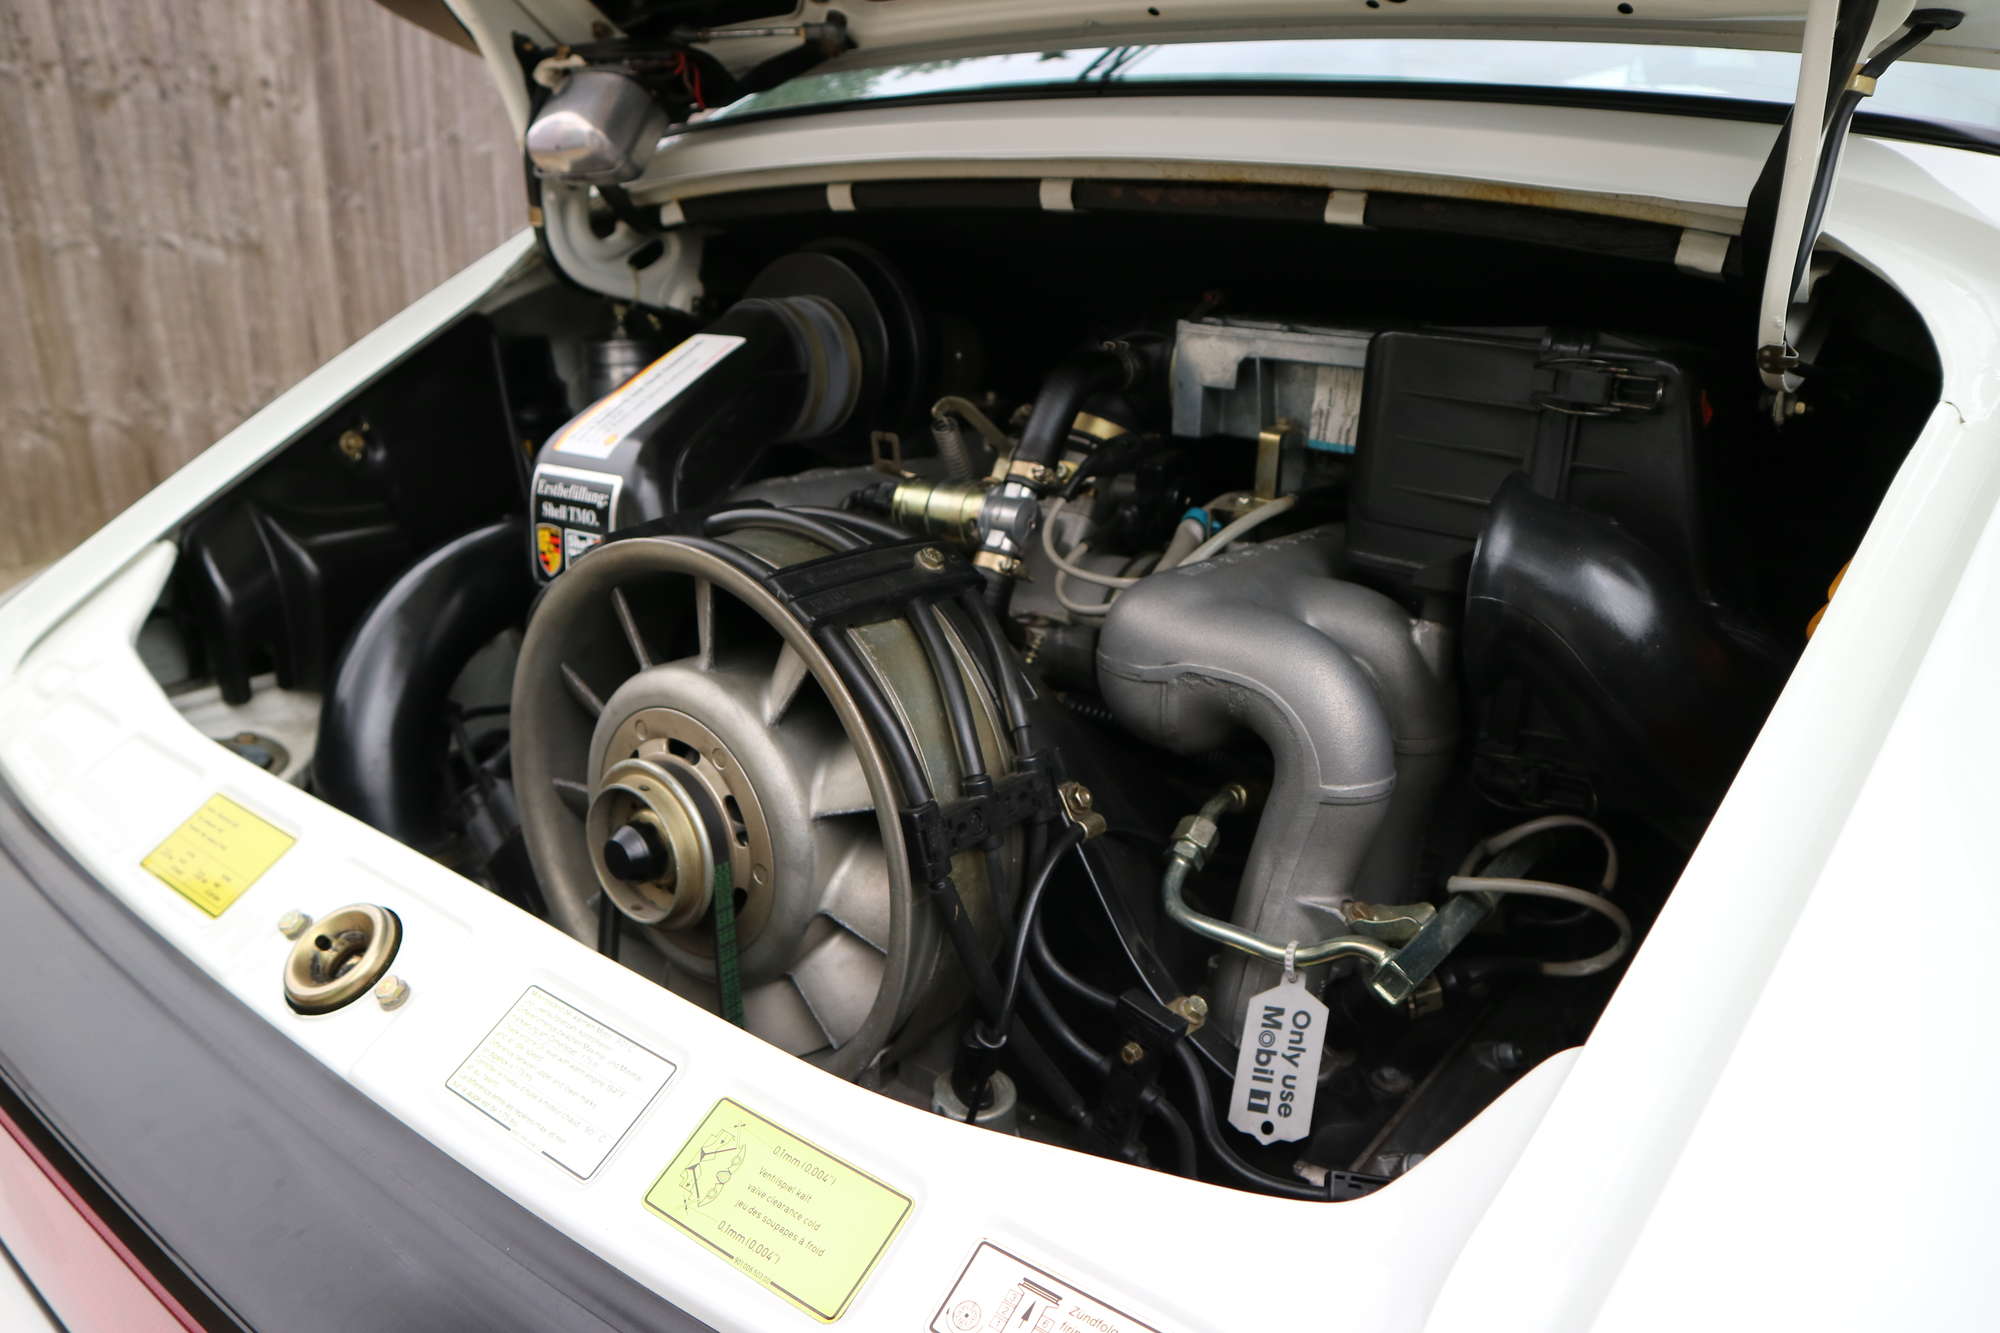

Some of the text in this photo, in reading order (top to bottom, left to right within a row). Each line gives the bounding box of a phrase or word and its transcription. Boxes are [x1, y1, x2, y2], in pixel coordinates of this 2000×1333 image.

[542, 501, 567, 521] Shell
[1252, 1005, 1285, 1083] Mobil
[1277, 1010, 1312, 1118] Only use
[766, 1195, 803, 1221] clearance
[803, 1216, 822, 1232] cold
[806, 1240, 826, 1257] froid
